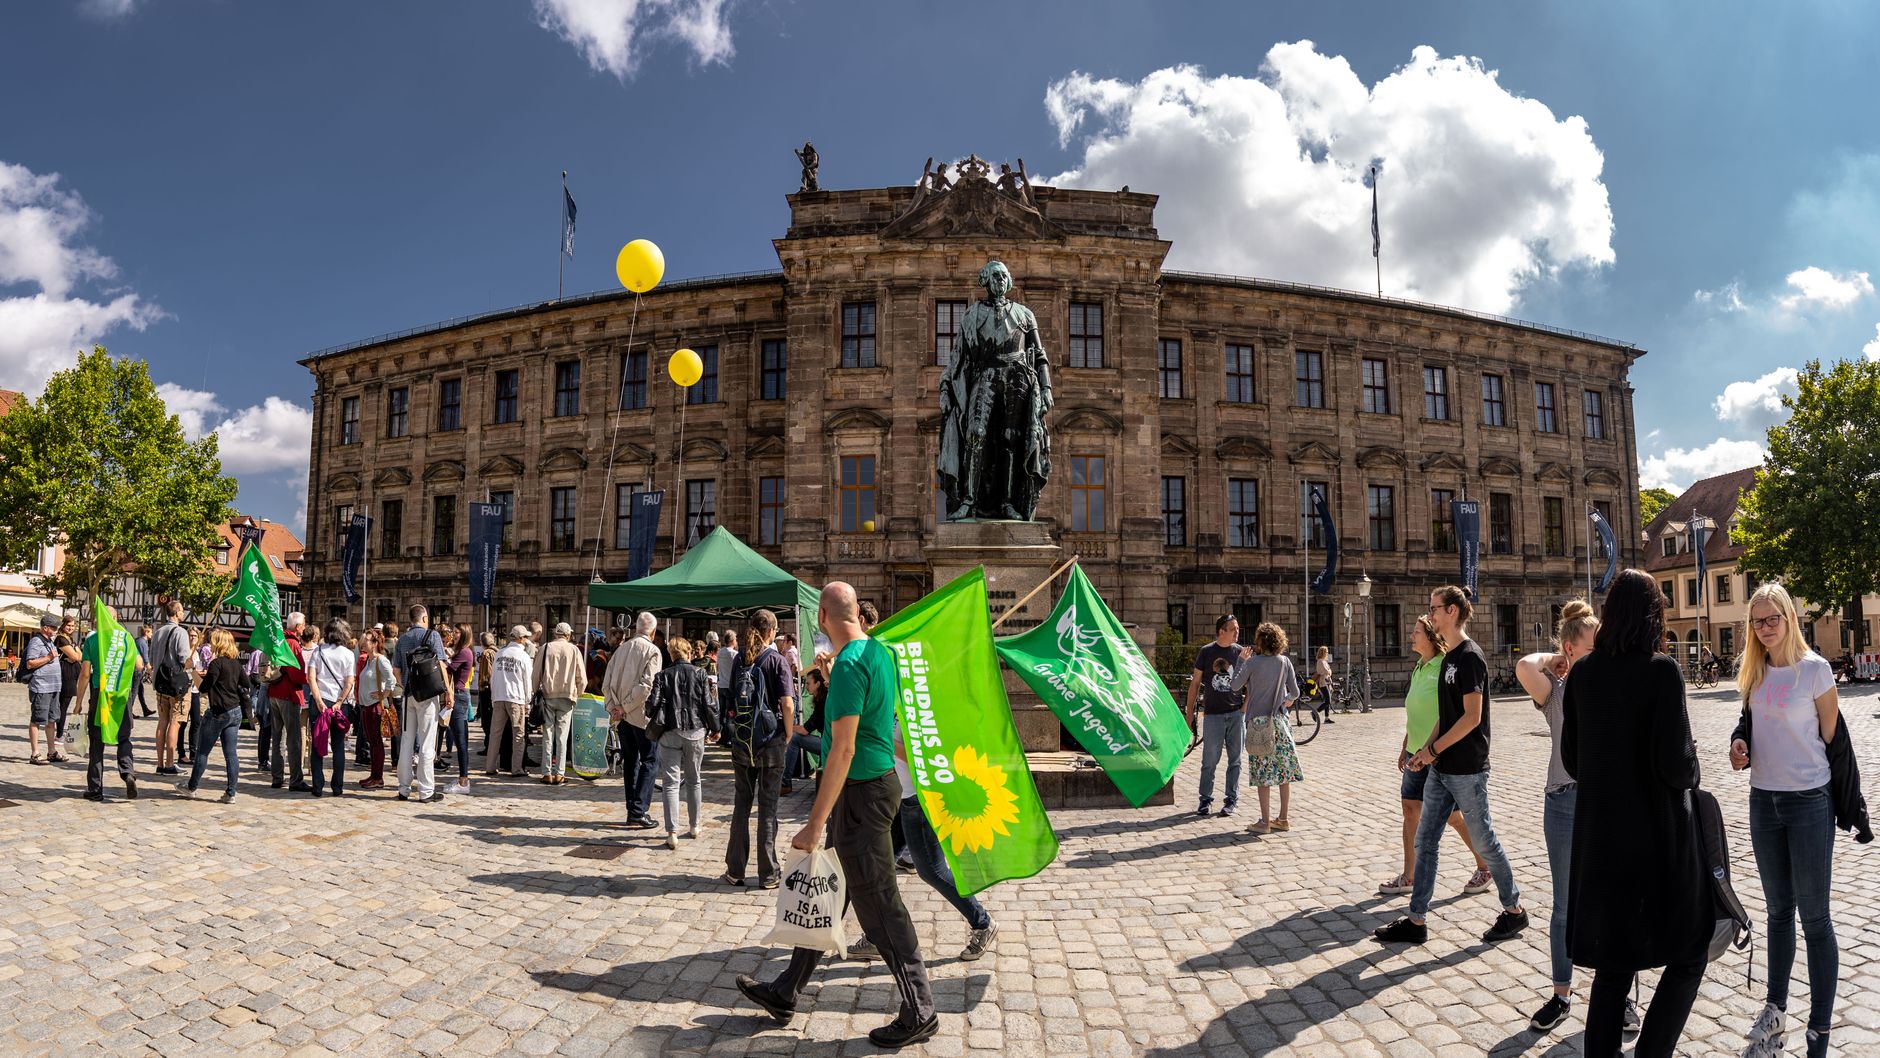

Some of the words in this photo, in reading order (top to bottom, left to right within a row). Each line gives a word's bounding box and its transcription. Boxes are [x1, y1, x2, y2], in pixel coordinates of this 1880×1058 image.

[643, 493, 661, 506] FAU
[1460, 503, 1477, 514] FAU
[481, 505, 502, 516] FAU
[245, 594, 268, 620] Grüne
[893, 642, 911, 679] DIE
[903, 688, 931, 787] GRÜNEN
[907, 641, 942, 748] BÜNDNIS
[928, 753, 955, 784] 90
[1033, 663, 1076, 702] Grüne
[1069, 699, 1130, 755] Jugend
[797, 900, 810, 915] IS
[810, 904, 820, 915] A
[783, 909, 832, 929] KILLER
